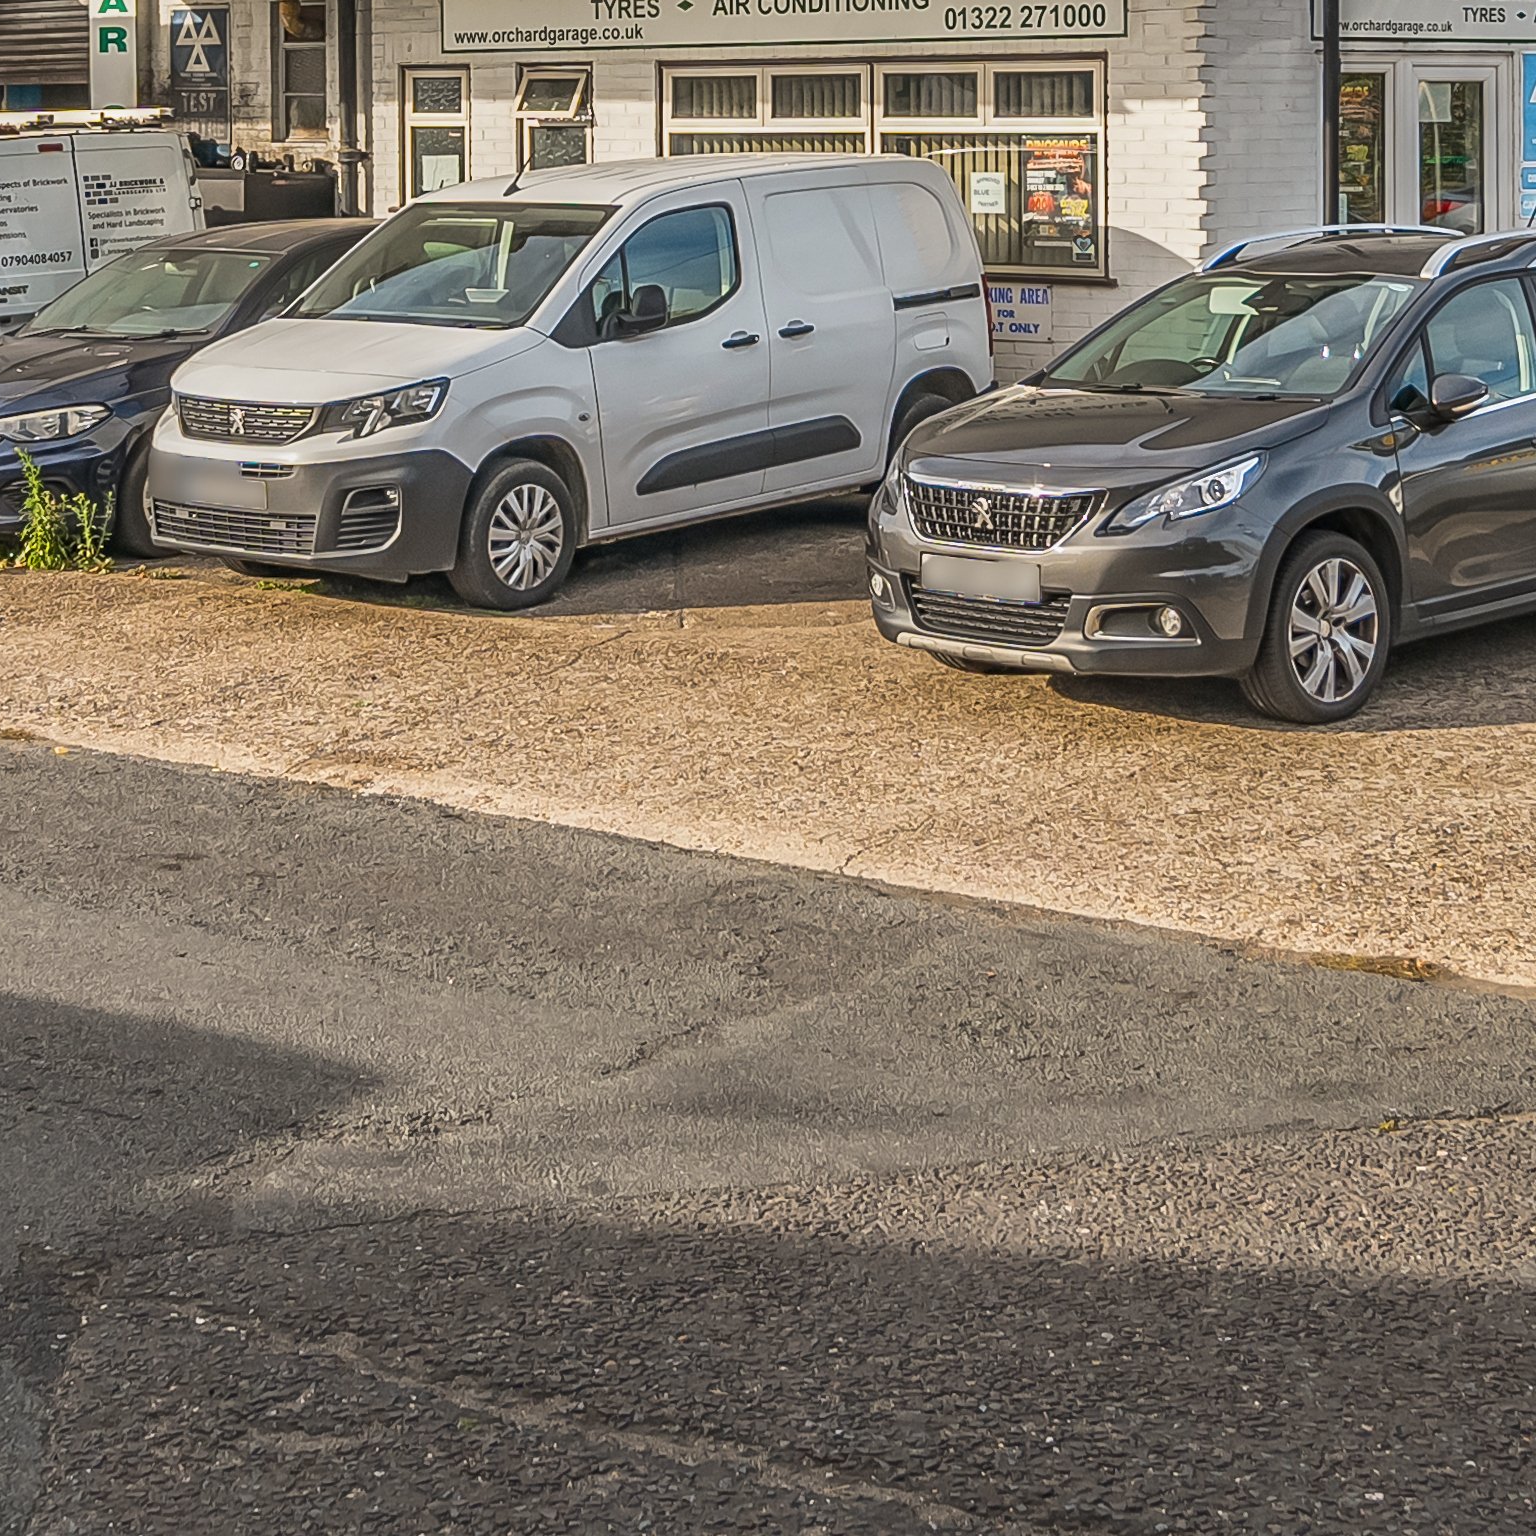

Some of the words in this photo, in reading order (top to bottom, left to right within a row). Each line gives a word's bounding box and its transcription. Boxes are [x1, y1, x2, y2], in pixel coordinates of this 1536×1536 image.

[944, 6, 1012, 30] 01322
[1020, 3, 1107, 29] 271000
[1462, 7, 1506, 23] TYRES
[454, 24, 644, 46] www.orchardgarage.co.uk
[180, 92, 217, 113] TEST
[22, 179, 31, 188] of
[32, 177, 68, 187] Brickwork
[88, 211, 123, 220] Specialists
[133, 206, 165, 216] Brickwork
[92, 221, 105, 230] and
[107, 220, 123, 229] Hard
[125, 218, 164, 227] Landscaping
[1, 251, 72, 268] 07904084057
[1020, 287, 1049, 304] AREA
[997, 309, 1015, 319] FOR
[1009, 322, 1040, 334] ONLY
